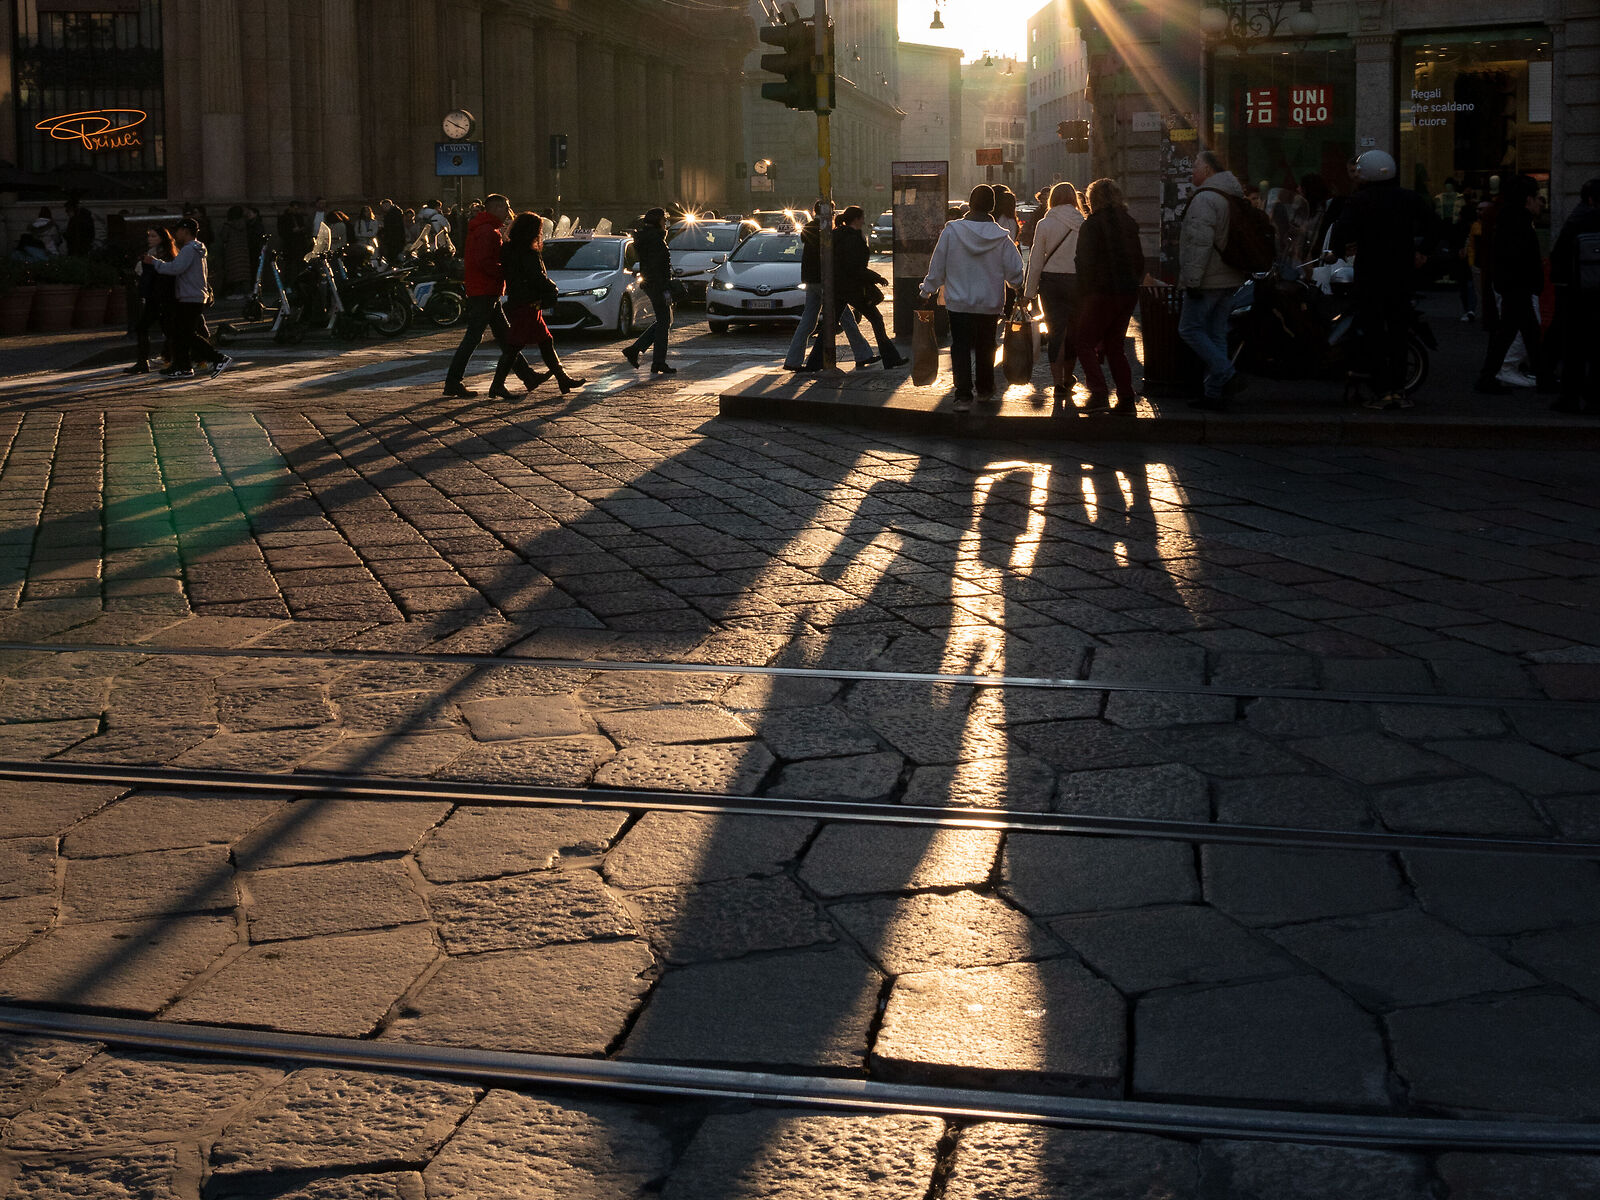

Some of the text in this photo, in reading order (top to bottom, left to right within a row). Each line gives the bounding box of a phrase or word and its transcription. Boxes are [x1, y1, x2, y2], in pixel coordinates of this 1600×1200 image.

[1293, 89, 1325, 105] UNI
[1411, 88, 1441, 100] Regali
[1411, 101, 1475, 112] che scaldano
[1293, 106, 1328, 124] QLO
[1418, 117, 1447, 126] cuore
[35, 108, 147, 150] Princi
